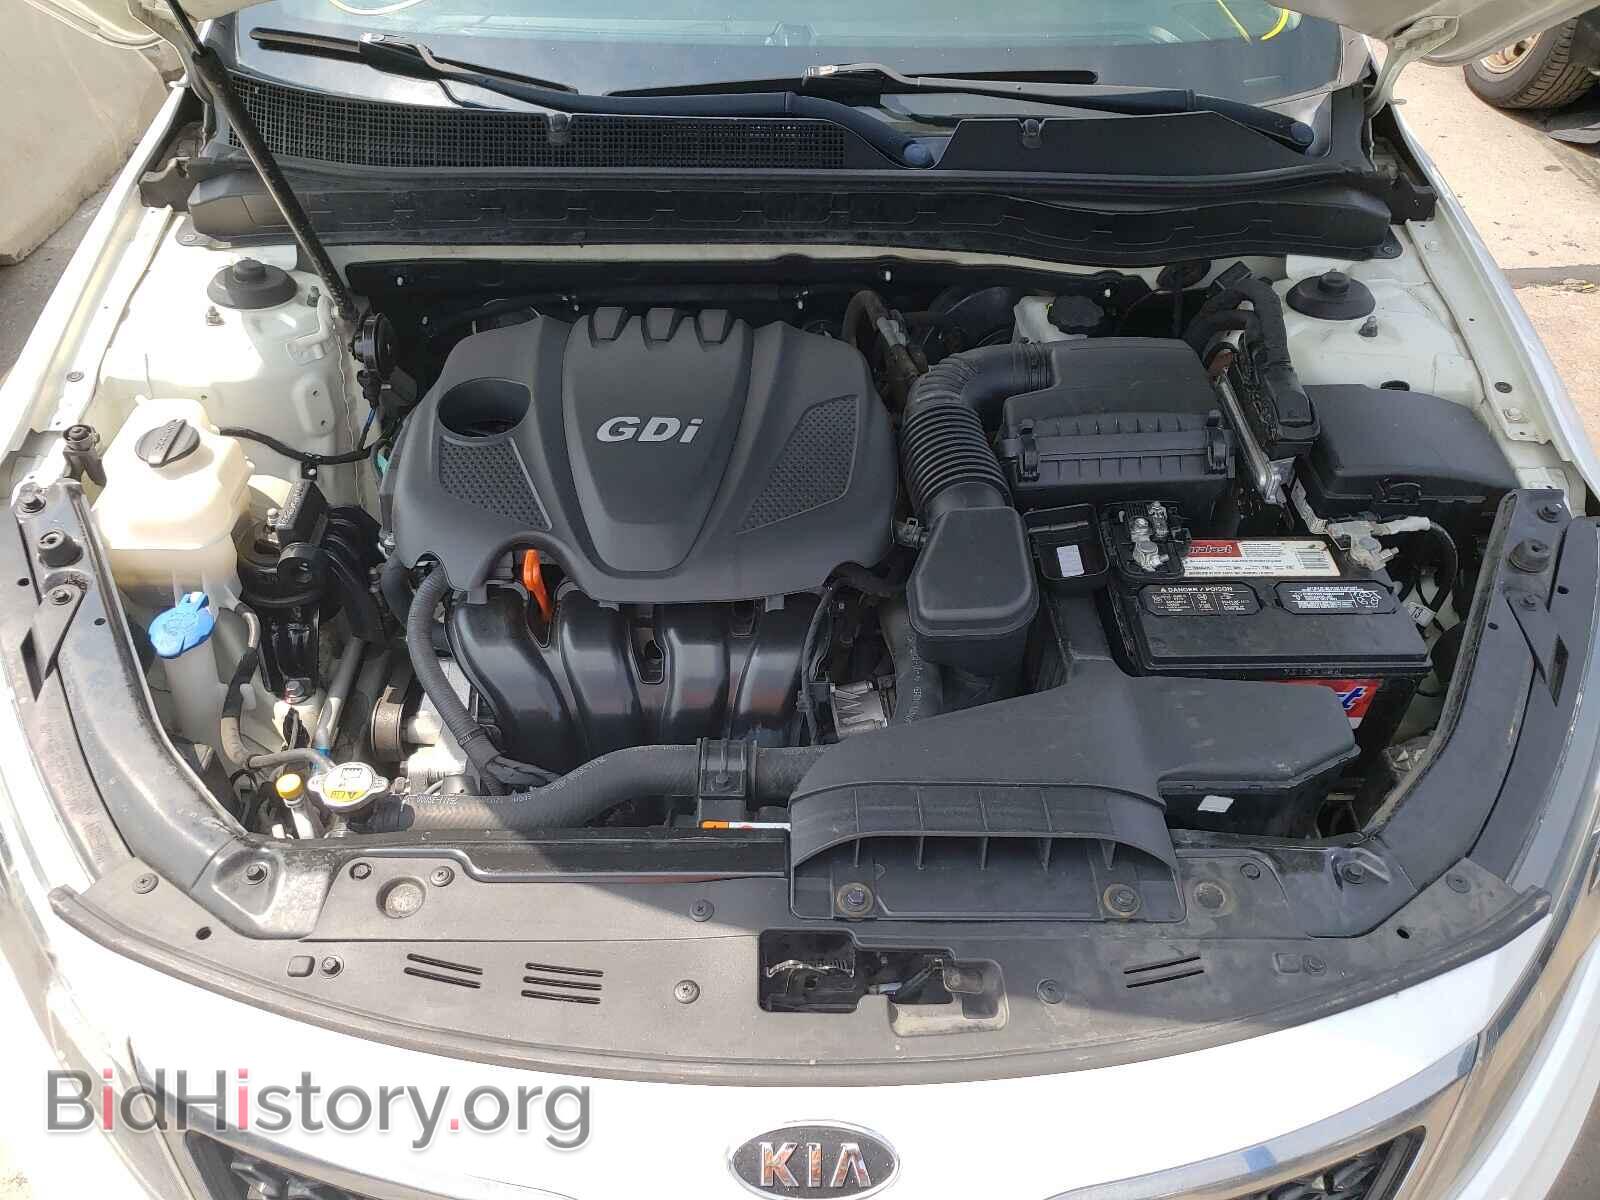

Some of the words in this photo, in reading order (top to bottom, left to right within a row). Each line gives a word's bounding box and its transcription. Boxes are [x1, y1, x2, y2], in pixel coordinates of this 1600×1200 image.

[596, 416, 704, 443] GDi
[1336, 685, 1368, 711] t
[759, 1141, 872, 1188] KIA
